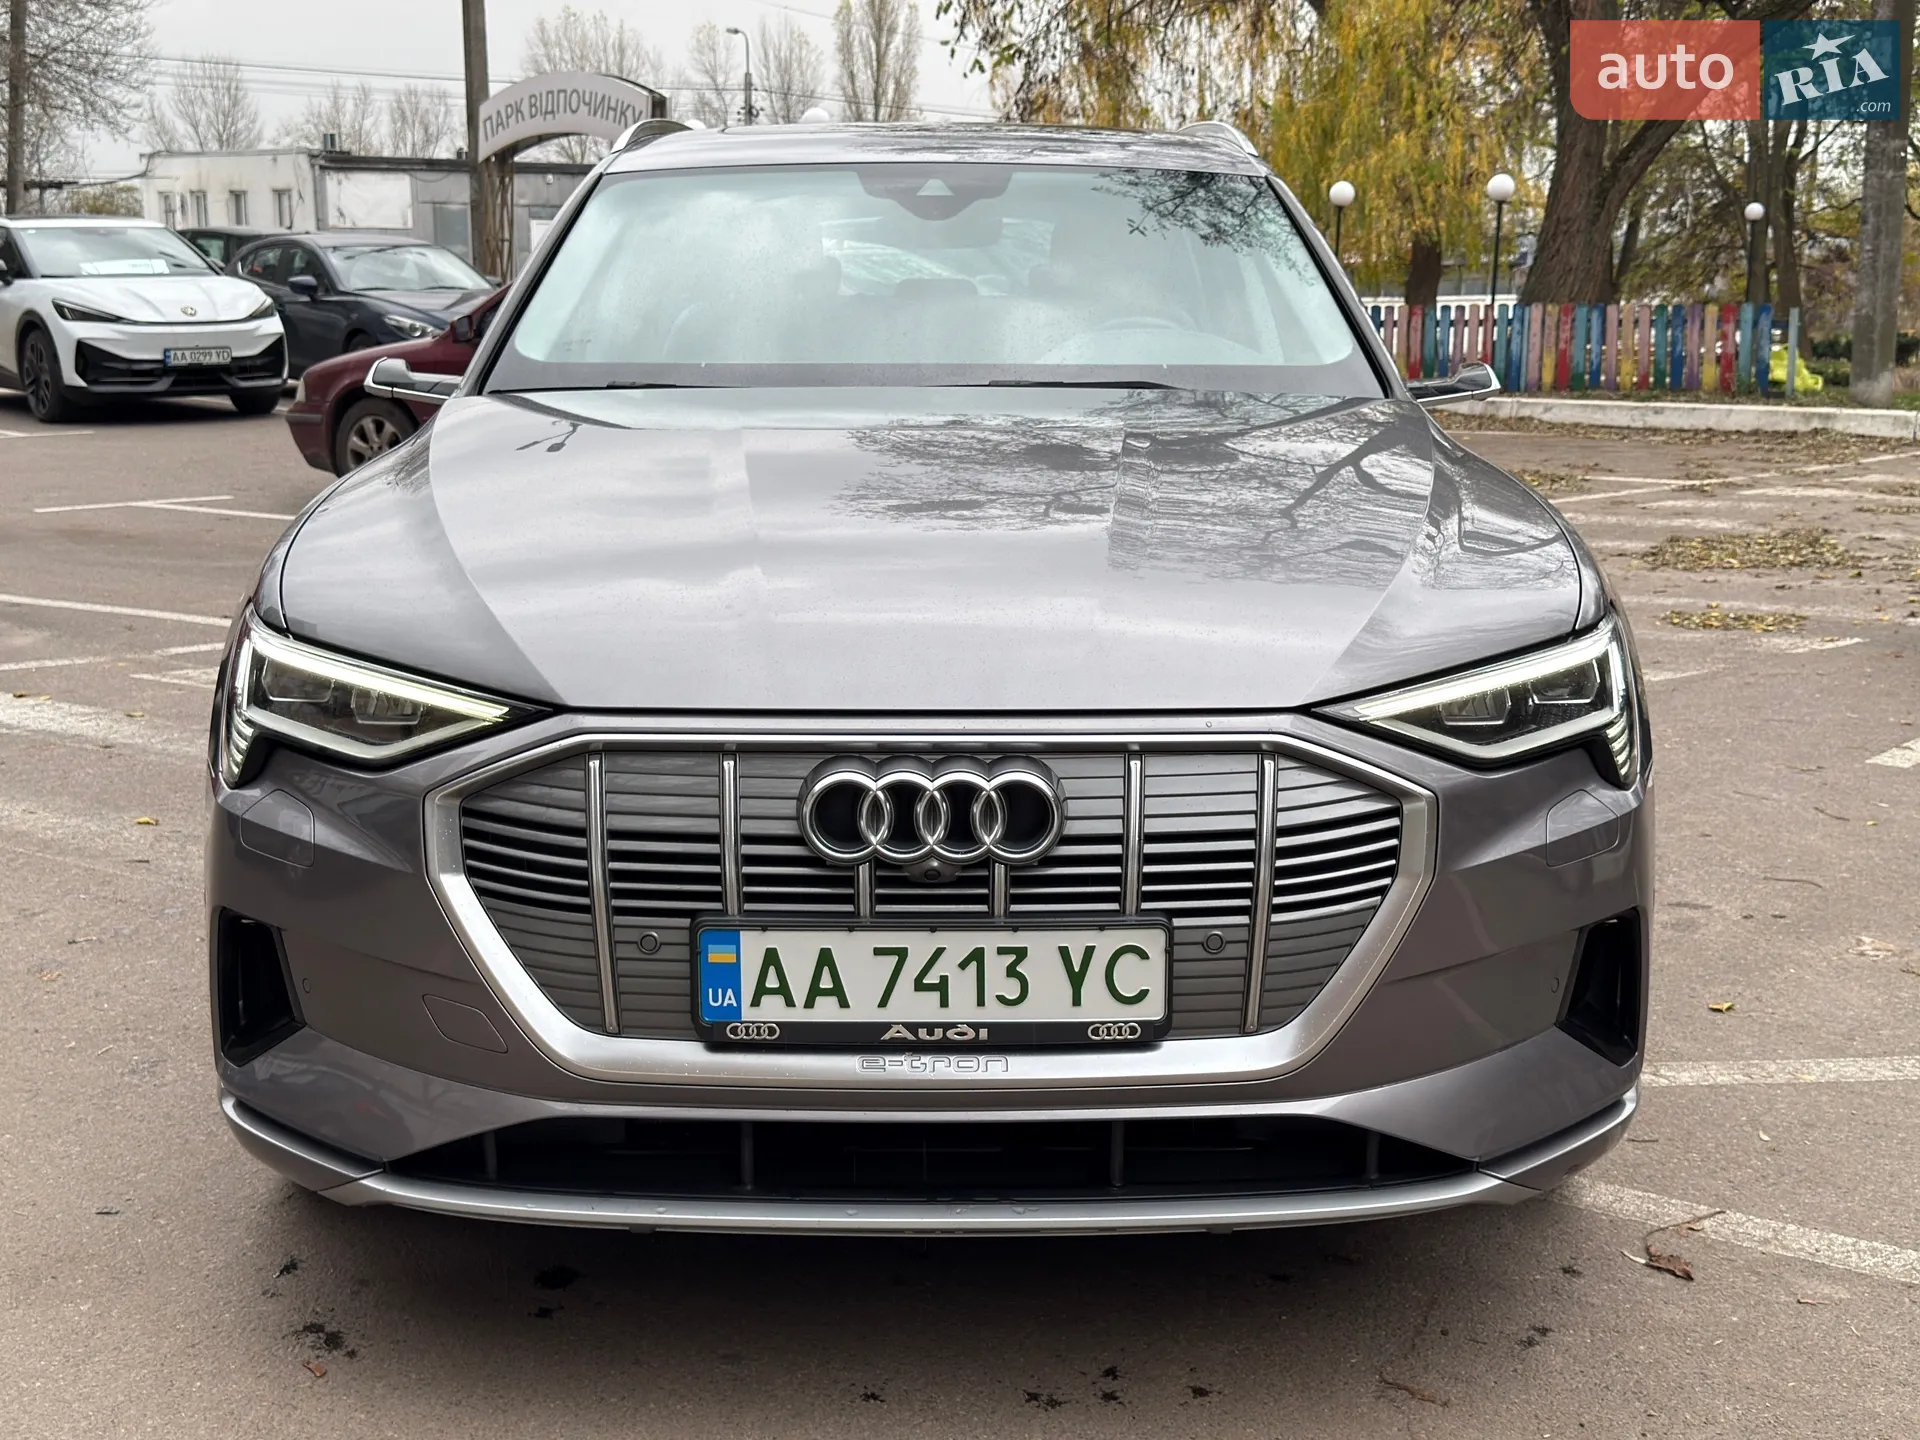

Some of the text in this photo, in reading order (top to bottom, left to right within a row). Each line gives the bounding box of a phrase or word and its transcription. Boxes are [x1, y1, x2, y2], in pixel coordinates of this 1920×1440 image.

[483, 88, 643, 142] ПАРК ВІДПОЧИНКУ
[173, 351, 188, 362] AA
[190, 350, 213, 362] 0299
[749, 944, 1152, 1009] AA 7413 YC
[708, 987, 738, 1007] UA
[880, 1023, 989, 1041] Audi
[855, 1052, 1009, 1073] e-tron
